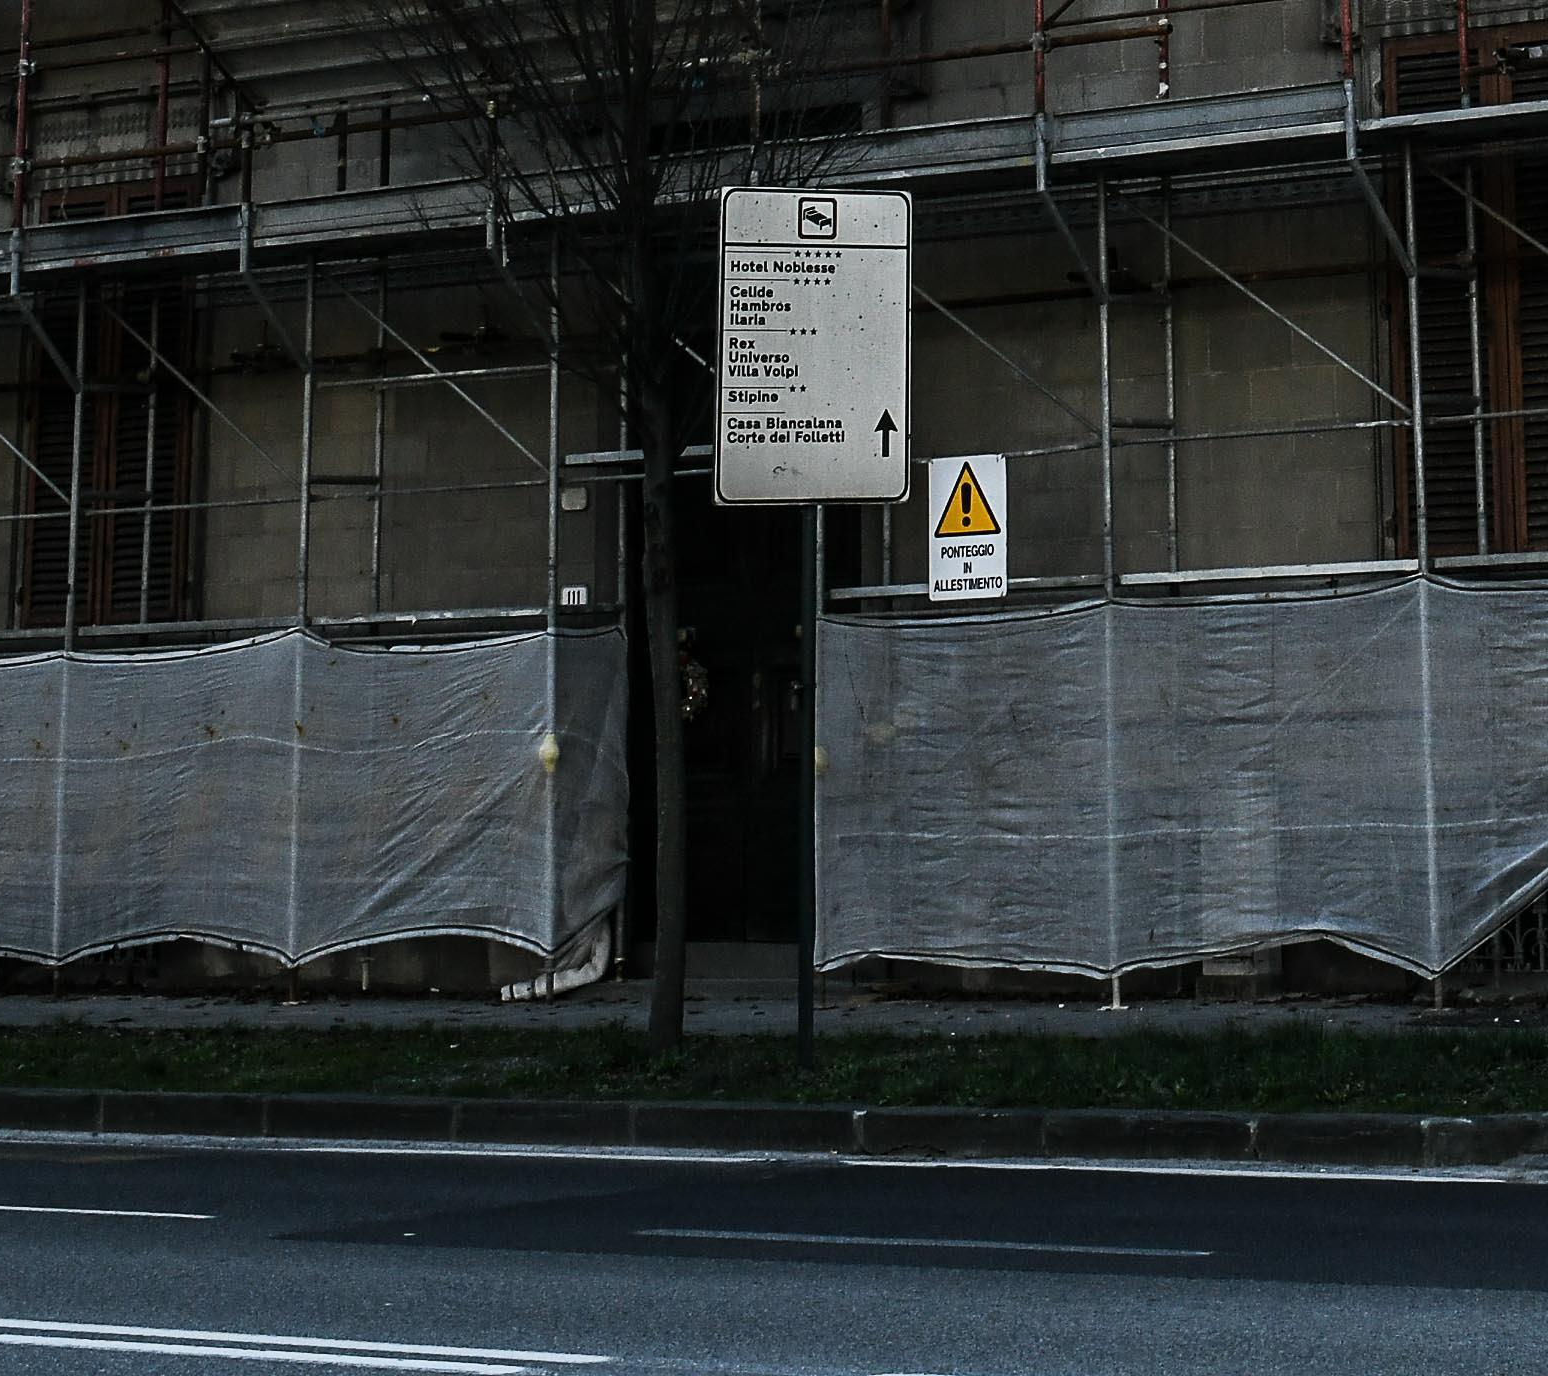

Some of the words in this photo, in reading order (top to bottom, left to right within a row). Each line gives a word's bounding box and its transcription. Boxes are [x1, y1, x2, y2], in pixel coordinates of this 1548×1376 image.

[730, 260, 768, 273] Hotel
[772, 260, 836, 274] Noblesse
[730, 285, 774, 298] Celide
[730, 299, 792, 312] Hambros
[730, 313, 766, 326] Ilaria
[729, 337, 756, 349] Rex
[728, 351, 790, 363] Universo
[728, 364, 760, 377] Villa
[763, 364, 799, 379] Volpi
[727, 417, 761, 429] Casa
[766, 417, 843, 429] Biancalana
[727, 431, 766, 443] Corte
[769, 431, 790, 443] dei
[794, 431, 845, 443] Folletti
[940, 544, 995, 559] PONTEGGIO
[963, 562, 973, 574] IN
[933, 576, 1003, 593] ALLESTIMENTO
